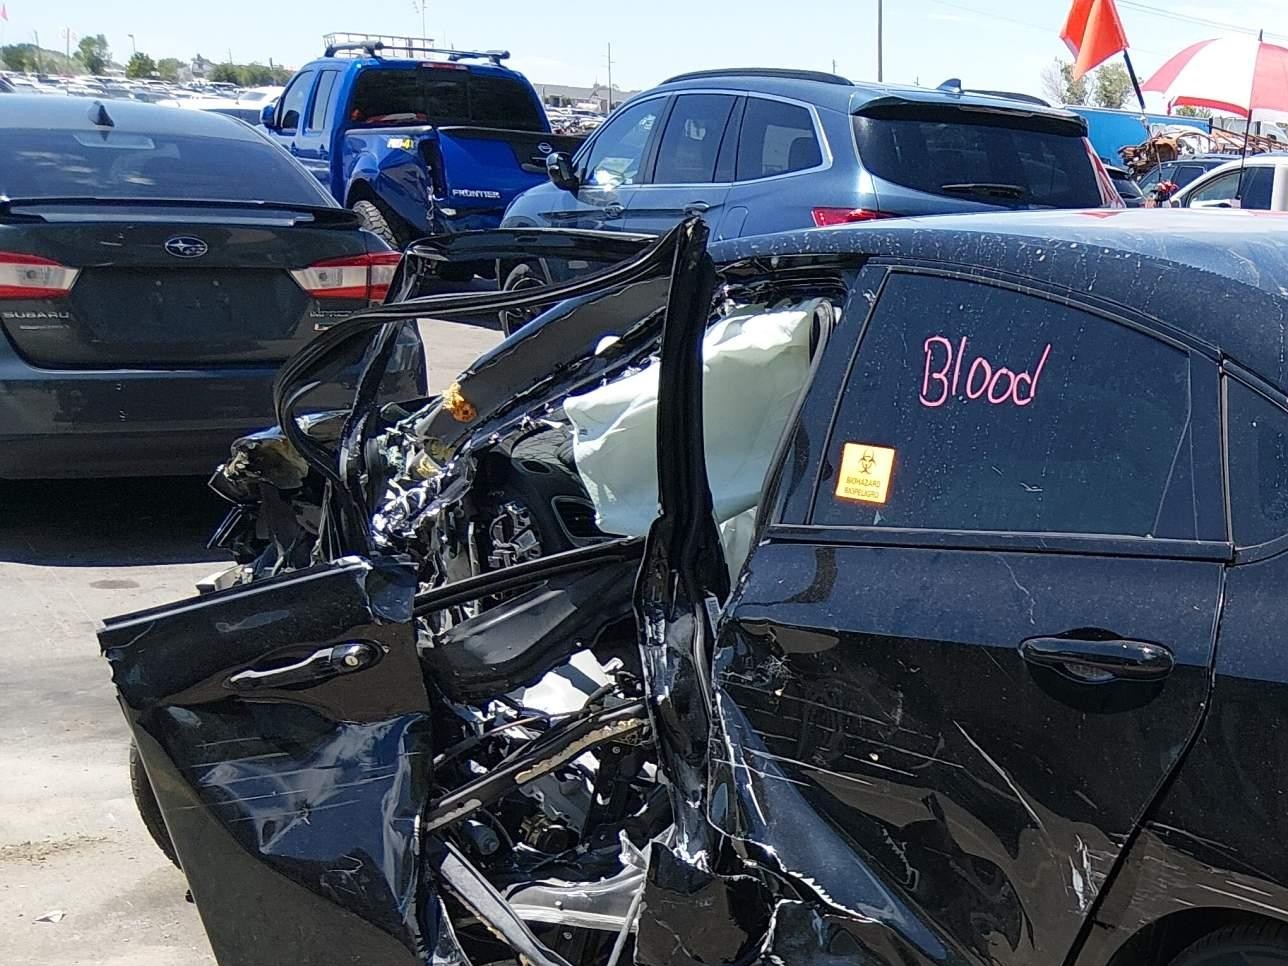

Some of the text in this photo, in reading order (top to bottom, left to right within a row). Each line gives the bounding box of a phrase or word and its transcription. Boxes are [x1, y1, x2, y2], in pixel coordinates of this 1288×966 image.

[452, 189, 500, 198] FRONTIER
[3, 311, 70, 319] SUBARU
[919, 336, 1051, 407] Blood
[846, 476, 881, 488] BIOHAZARD
